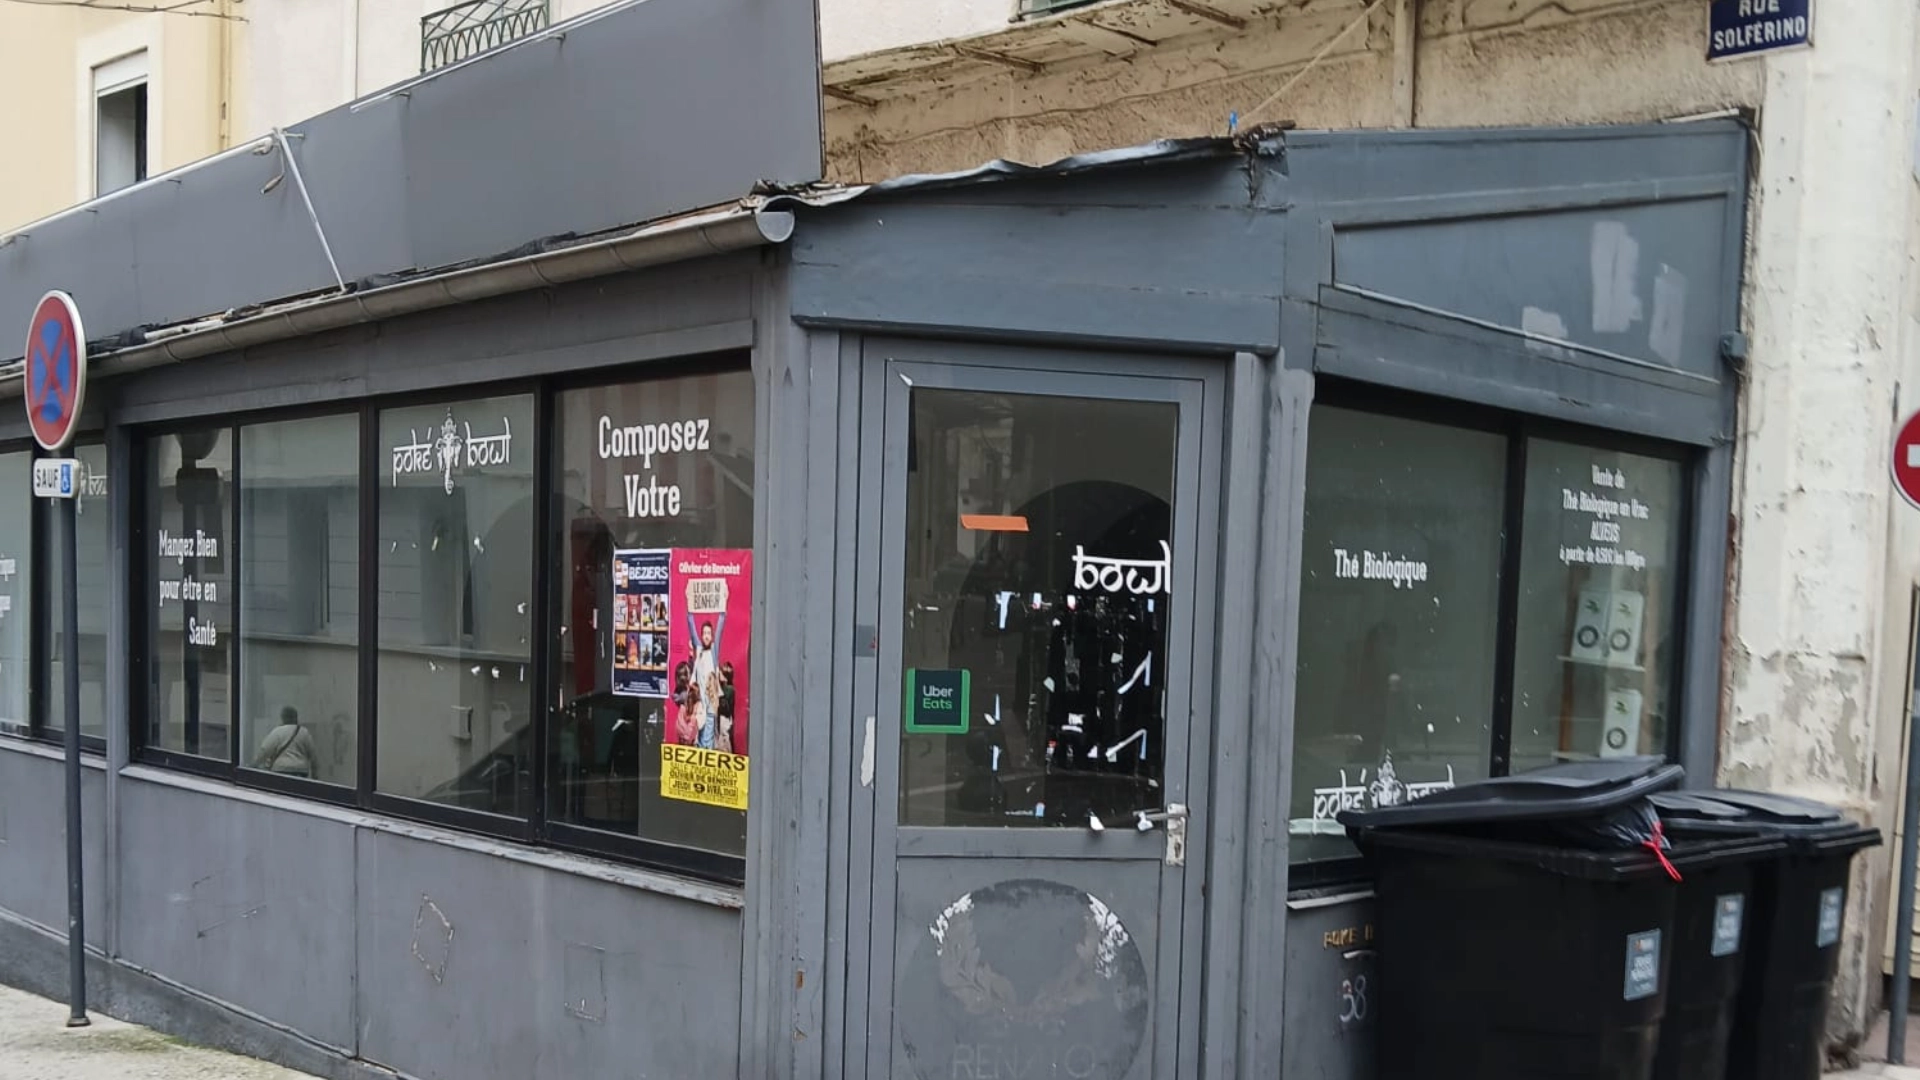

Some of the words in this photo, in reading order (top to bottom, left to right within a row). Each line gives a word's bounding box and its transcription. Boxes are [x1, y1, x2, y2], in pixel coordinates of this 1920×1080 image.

[1739, 0, 1780, 17] RUE
[465, 416, 511, 466] bowl
[599, 415, 710, 469] Composez
[36, 469, 59, 488] SAUF
[624, 474, 681, 518] Votre
[159, 529, 194, 565] Mangez
[196, 529, 217, 557] Bien
[1072, 540, 1171, 595] bowl
[1334, 548, 1359, 578] Thé
[1363, 549, 1427, 589] Biologique
[159, 580, 180, 607] pour
[182, 574, 202, 601] être
[204, 582, 217, 602] en
[189, 616, 217, 646] Santé
[923, 684, 953, 698] Uber
[923, 698, 952, 710] Eats
[663, 746, 745, 771] BEZIERS
